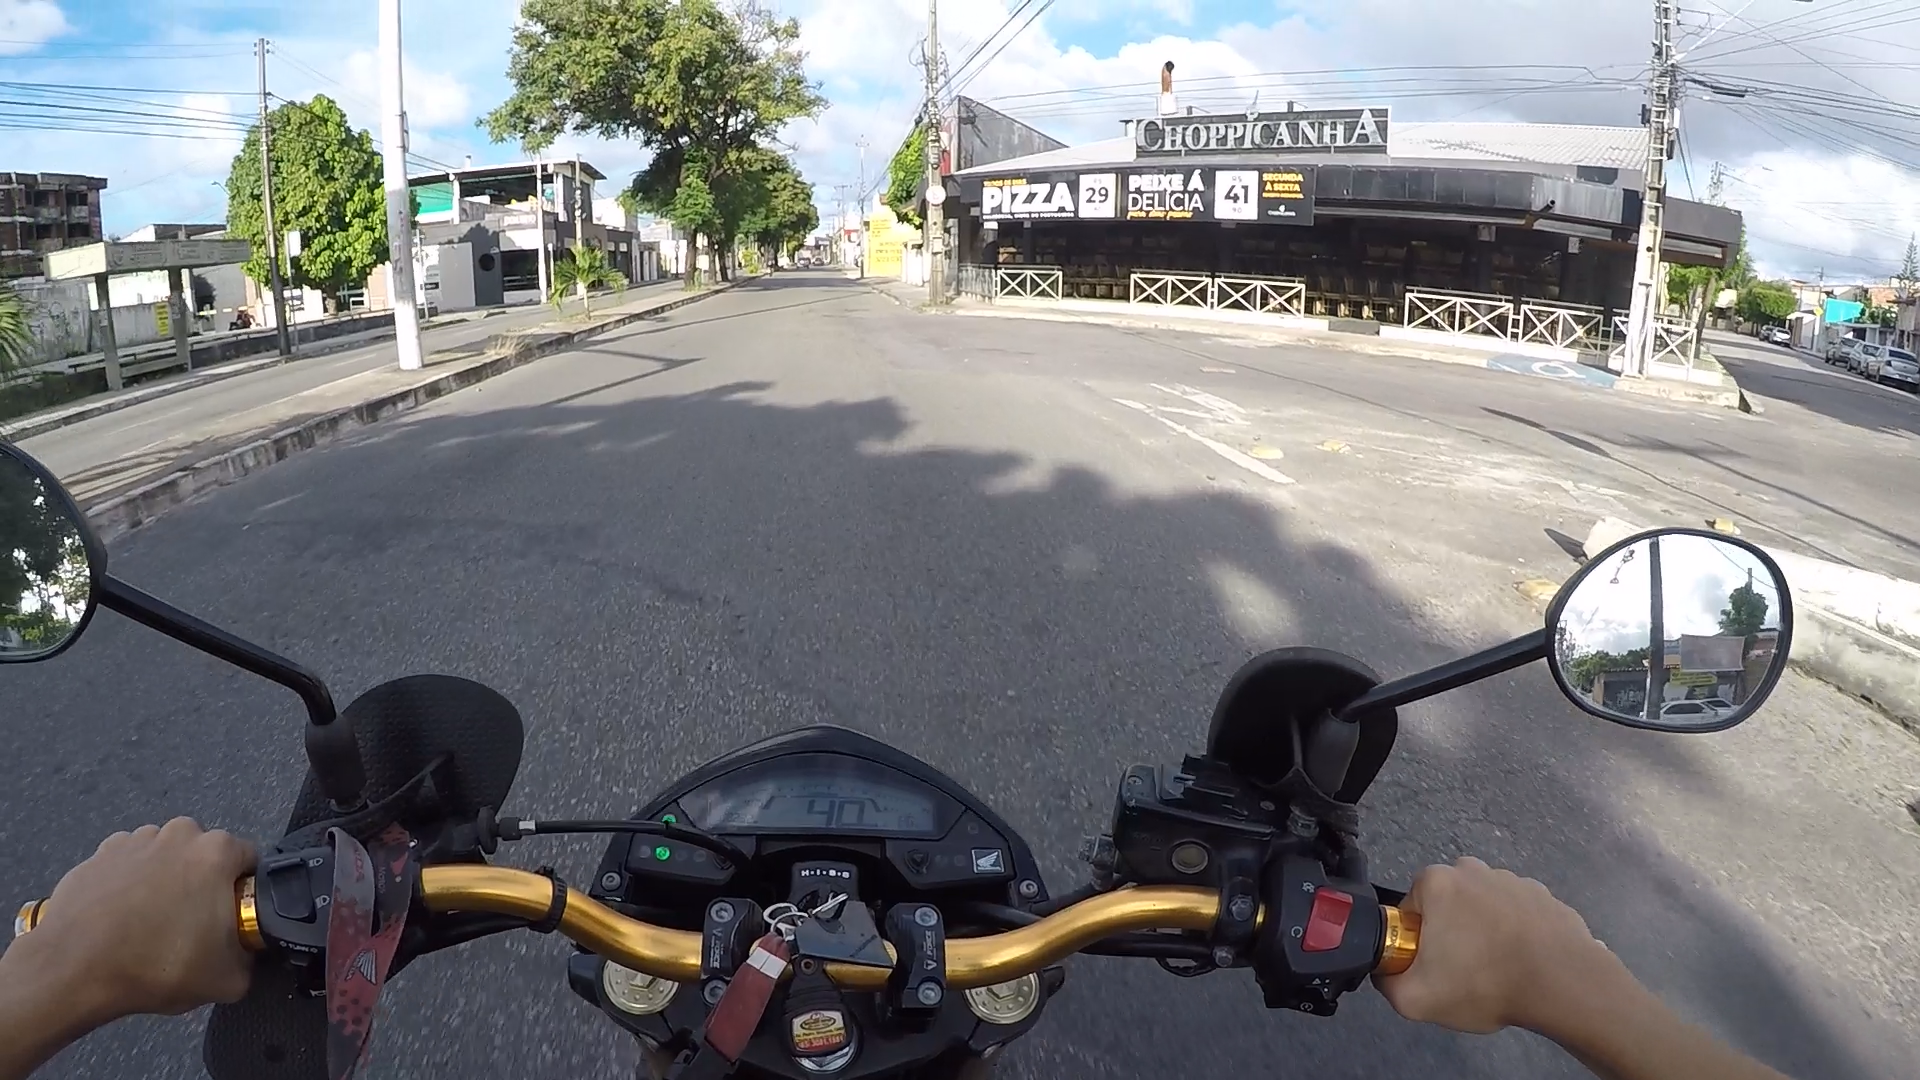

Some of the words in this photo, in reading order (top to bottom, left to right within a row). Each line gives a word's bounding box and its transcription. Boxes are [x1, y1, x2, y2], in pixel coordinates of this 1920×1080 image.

[1136, 108, 1386, 151] CHOPPICANHA
[1085, 186, 1109, 203] 29
[1128, 174, 1184, 192] PEIXE
[1224, 184, 1249, 204] 41
[982, 182, 1075, 214] PIZZA
[807, 799, 865, 828] 40
